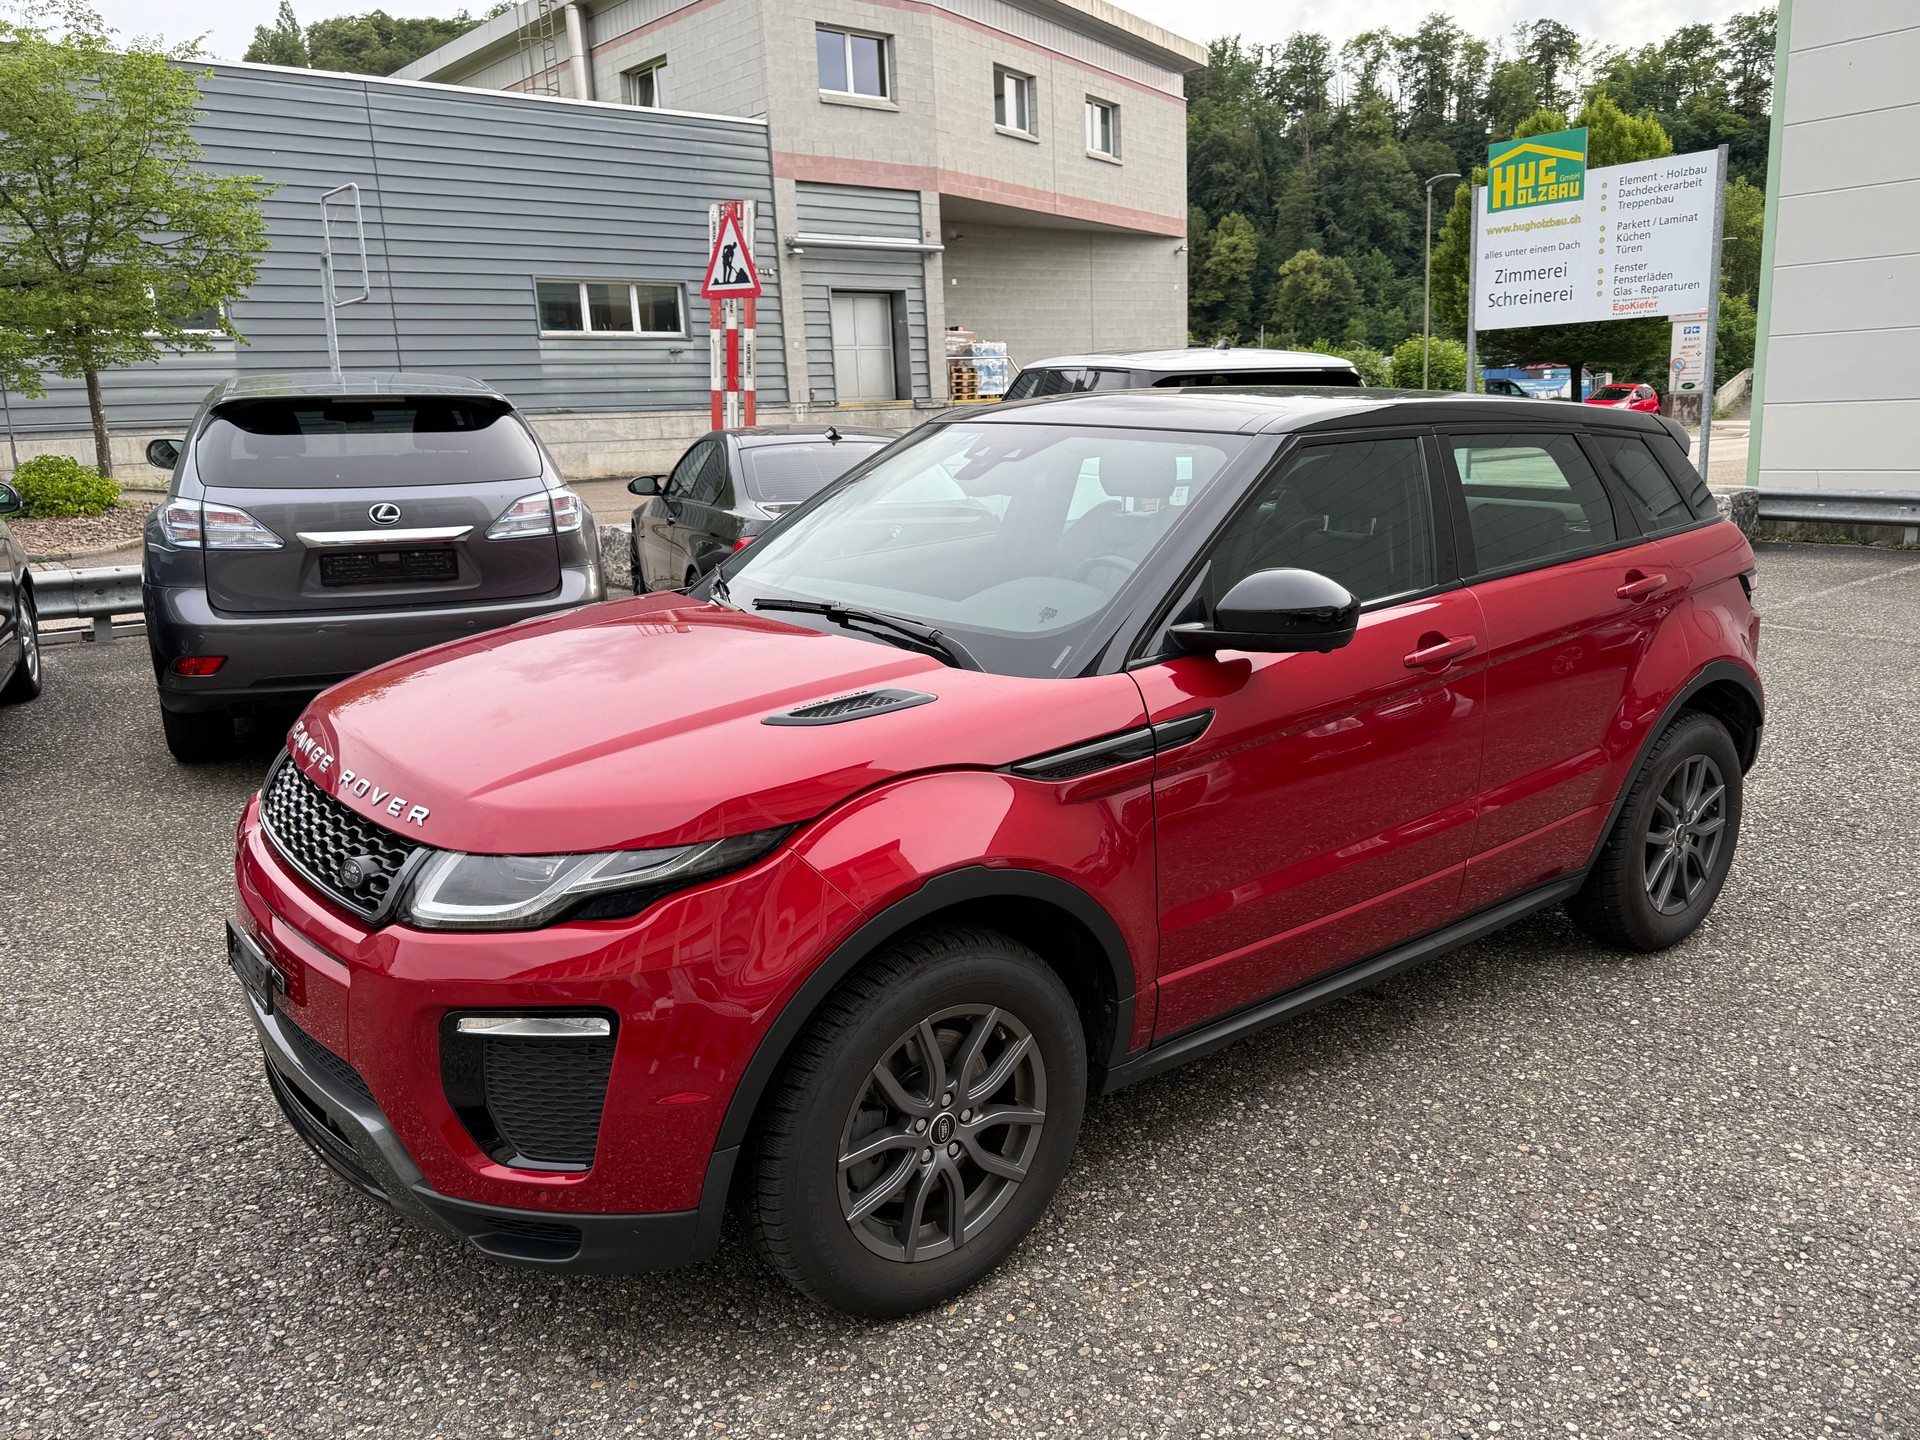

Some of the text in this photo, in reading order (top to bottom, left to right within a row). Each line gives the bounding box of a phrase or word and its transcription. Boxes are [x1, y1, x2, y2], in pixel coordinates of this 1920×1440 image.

[1493, 158, 1557, 208] HUG
[1560, 172, 1580, 182] GmbH
[1619, 173, 1657, 186] Element
[1667, 166, 1707, 179] Holzbau
[1618, 178, 1702, 198] Dachdeckerarbeit
[1618, 196, 1674, 210] Treppenbau
[1486, 214, 1581, 235] www.hugholzbau.ch
[1617, 219, 1650, 231] Parkett
[1659, 213, 1698, 226] Laminat
[1616, 231, 1651, 243] Küchen
[1484, 240, 1581, 260] alles unter einem Dach
[1616, 244, 1643, 255] Türen
[1495, 261, 1567, 284] Zimmerei
[1614, 263, 1648, 273] Fenster
[1613, 271, 1673, 285] Fensterläden
[1488, 285, 1573, 308] Schreinerei
[1613, 285, 1632, 297] Glas
[1640, 281, 1700, 295] Reparaturen
[1613, 300, 1658, 312] EgoKiefer
[292, 720, 430, 827] RANGE ROVER
